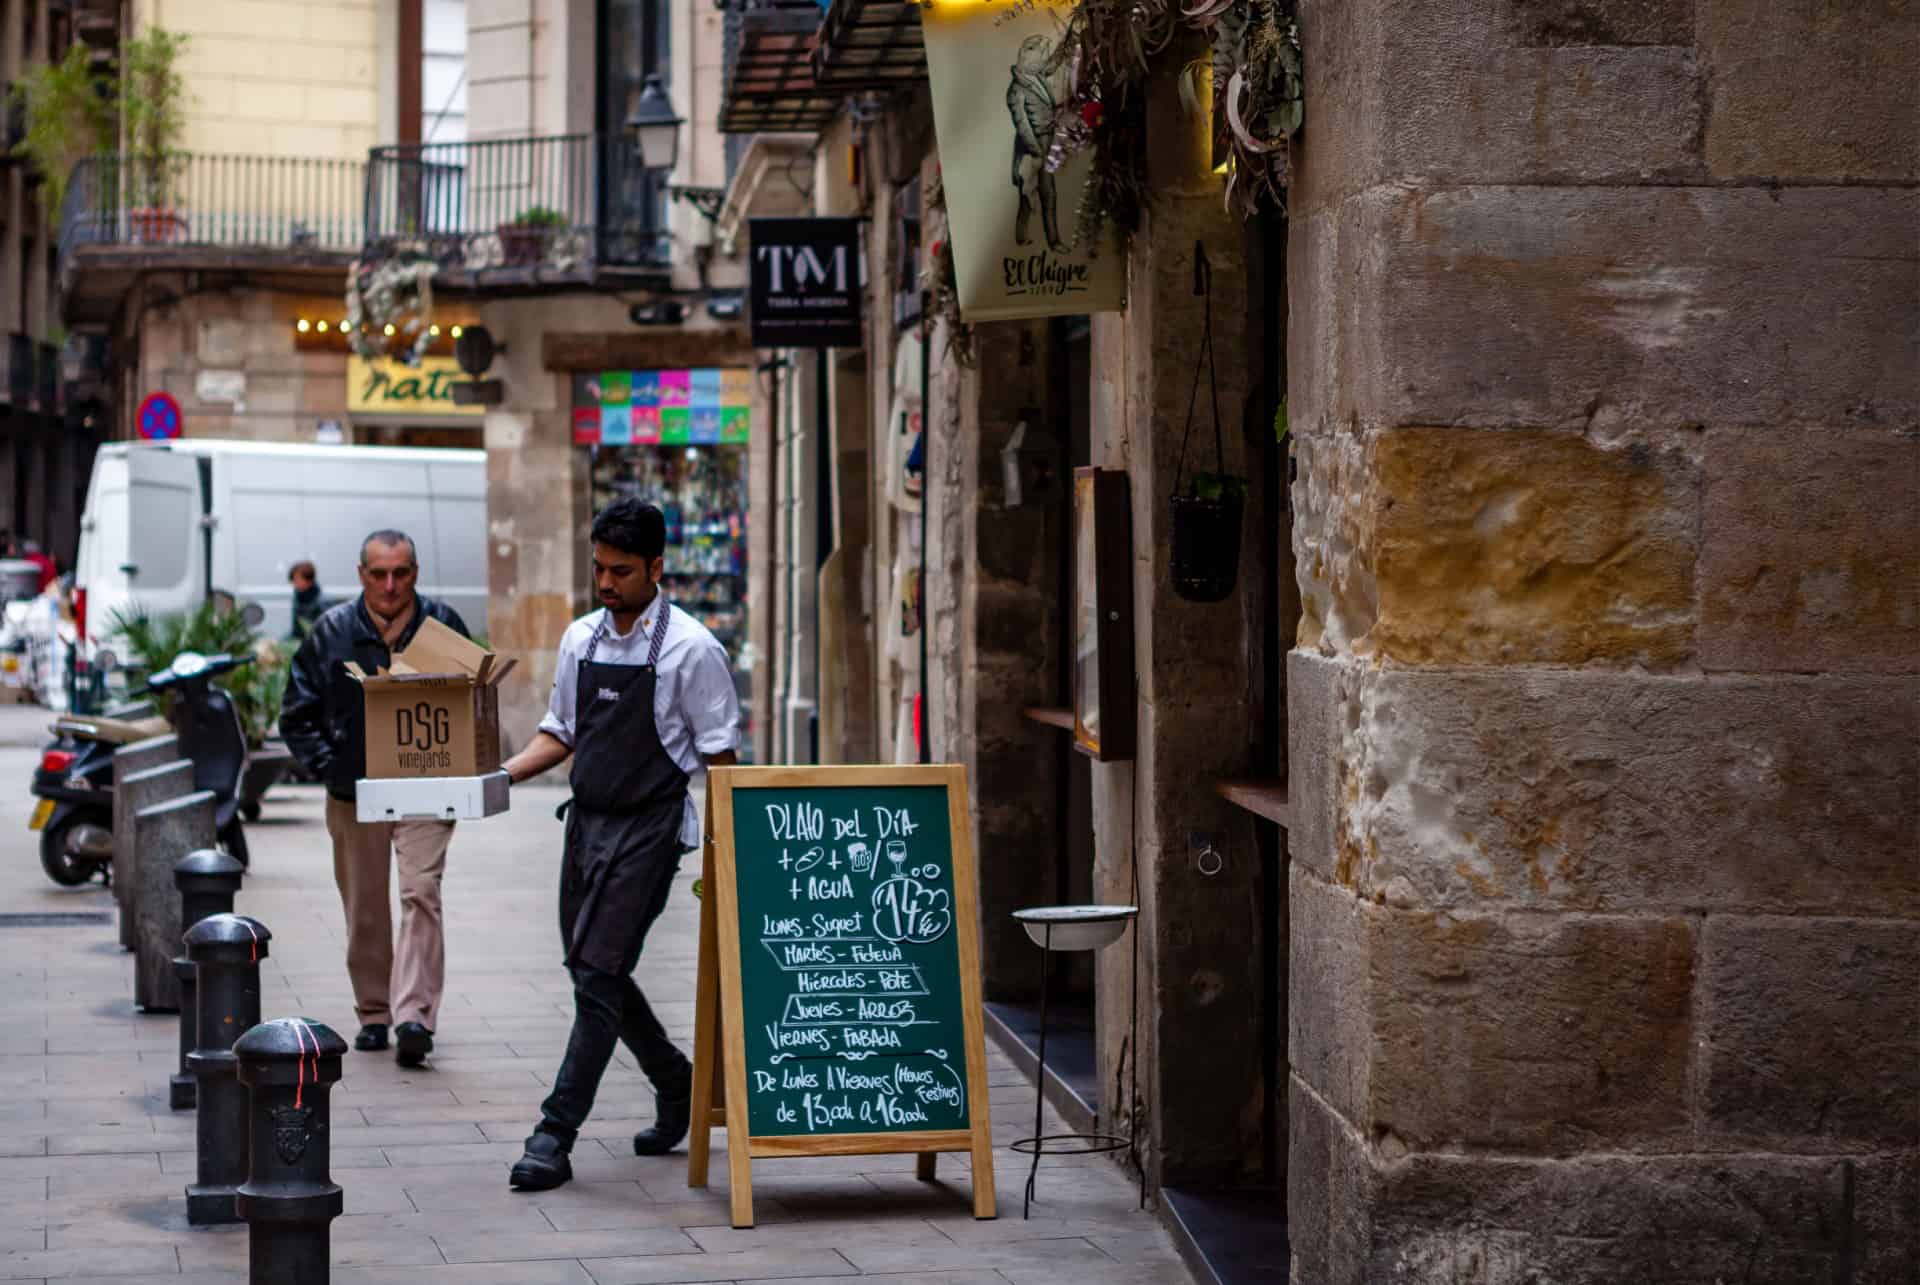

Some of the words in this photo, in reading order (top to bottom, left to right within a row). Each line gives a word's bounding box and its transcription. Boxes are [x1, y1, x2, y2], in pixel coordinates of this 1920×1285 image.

[1003, 256, 1025, 287] El
[1028, 250, 1088, 295] Chigre
[396, 702, 450, 751] DSG
[398, 748, 451, 774] vineyards
[808, 873, 854, 900] AGUA
[753, 1070, 777, 1093] De
[776, 1101, 798, 1123] de
